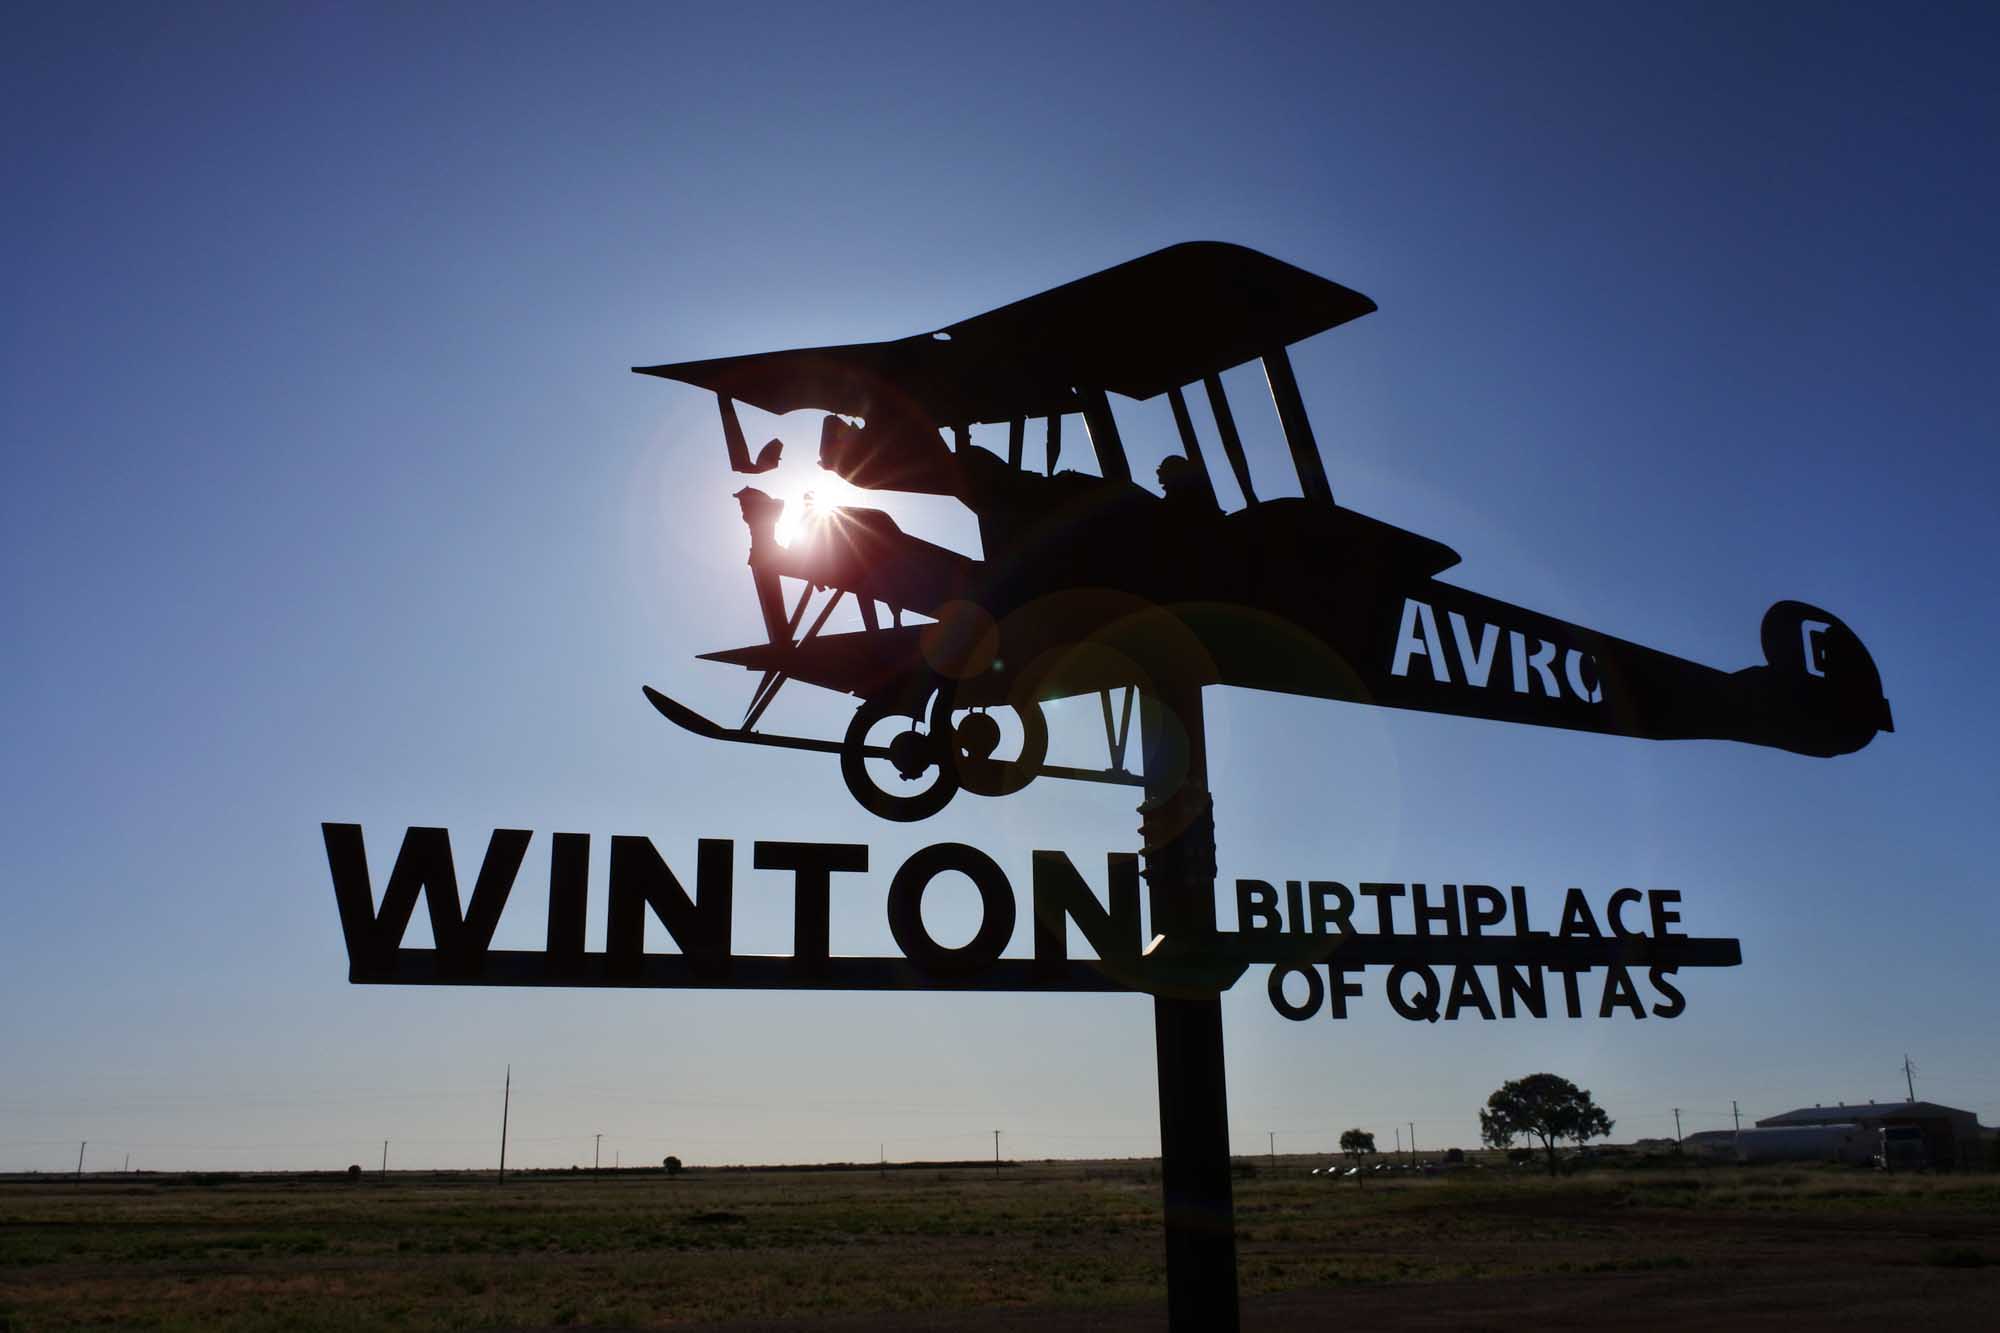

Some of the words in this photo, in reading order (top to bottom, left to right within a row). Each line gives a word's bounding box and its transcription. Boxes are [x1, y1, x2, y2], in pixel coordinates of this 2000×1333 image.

[321, 821, 1145, 985] WINTON
[1235, 878, 1688, 939] BIRTHPLACE
[1267, 961, 1365, 1021] OF
[1386, 961, 1686, 1023] QANTAS
